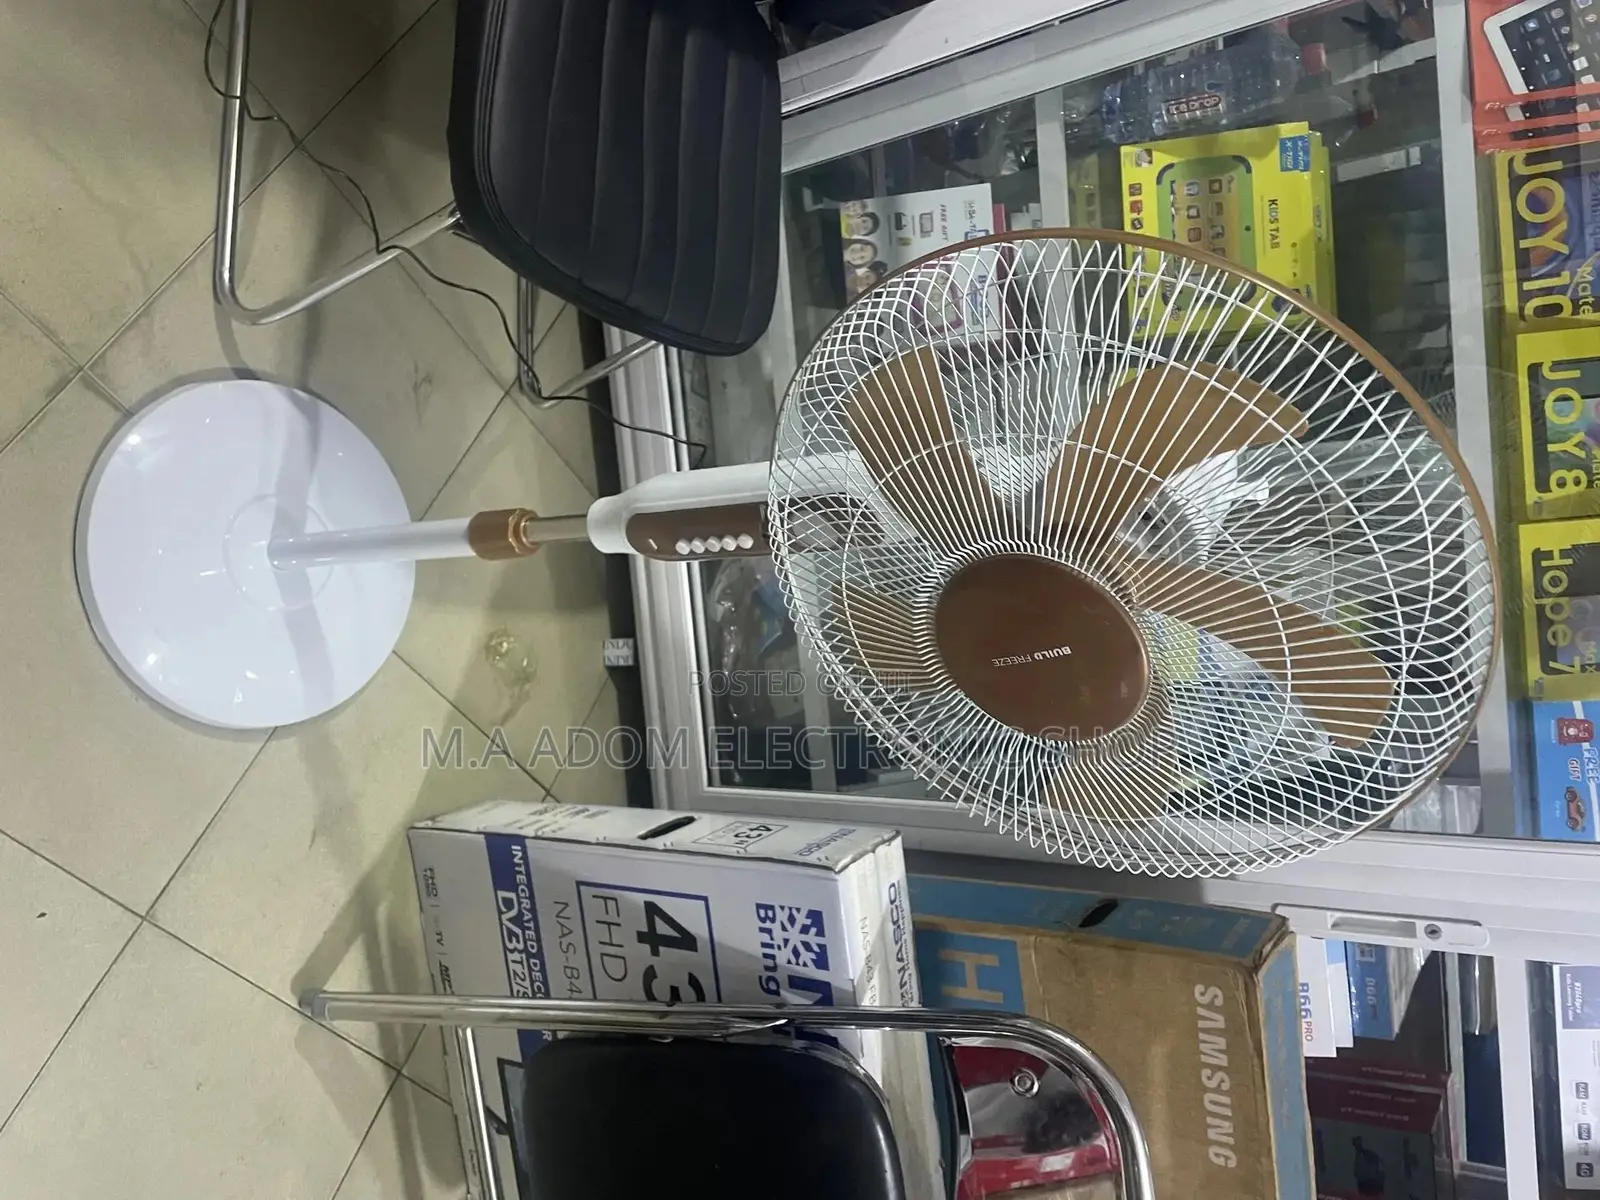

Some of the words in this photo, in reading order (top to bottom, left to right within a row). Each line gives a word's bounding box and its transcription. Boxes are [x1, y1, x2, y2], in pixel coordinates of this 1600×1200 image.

[1269, 229, 1280, 249] TAB
[1512, 153, 1570, 254] JOY
[1534, 544, 1574, 647] Hope
[992, 654, 1032, 667] FREEZE
[1034, 646, 1072, 661] BUILD
[1548, 656, 1580, 675] 7
[1567, 758, 1581, 782] GIFT
[1583, 747, 1600, 785] FREE
[435, 931, 444, 947] TV
[511, 845, 536, 953] INTEGRATED
[591, 894, 629, 982] FHD
[888, 883, 907, 989] NASCO
[553, 901, 583, 999] NAS-B4
[635, 900, 707, 1007] 43
[755, 903, 781, 997] Bring
[1303, 1021, 1314, 1042] PRO
[1194, 984, 1237, 1168] SAMSUNG
